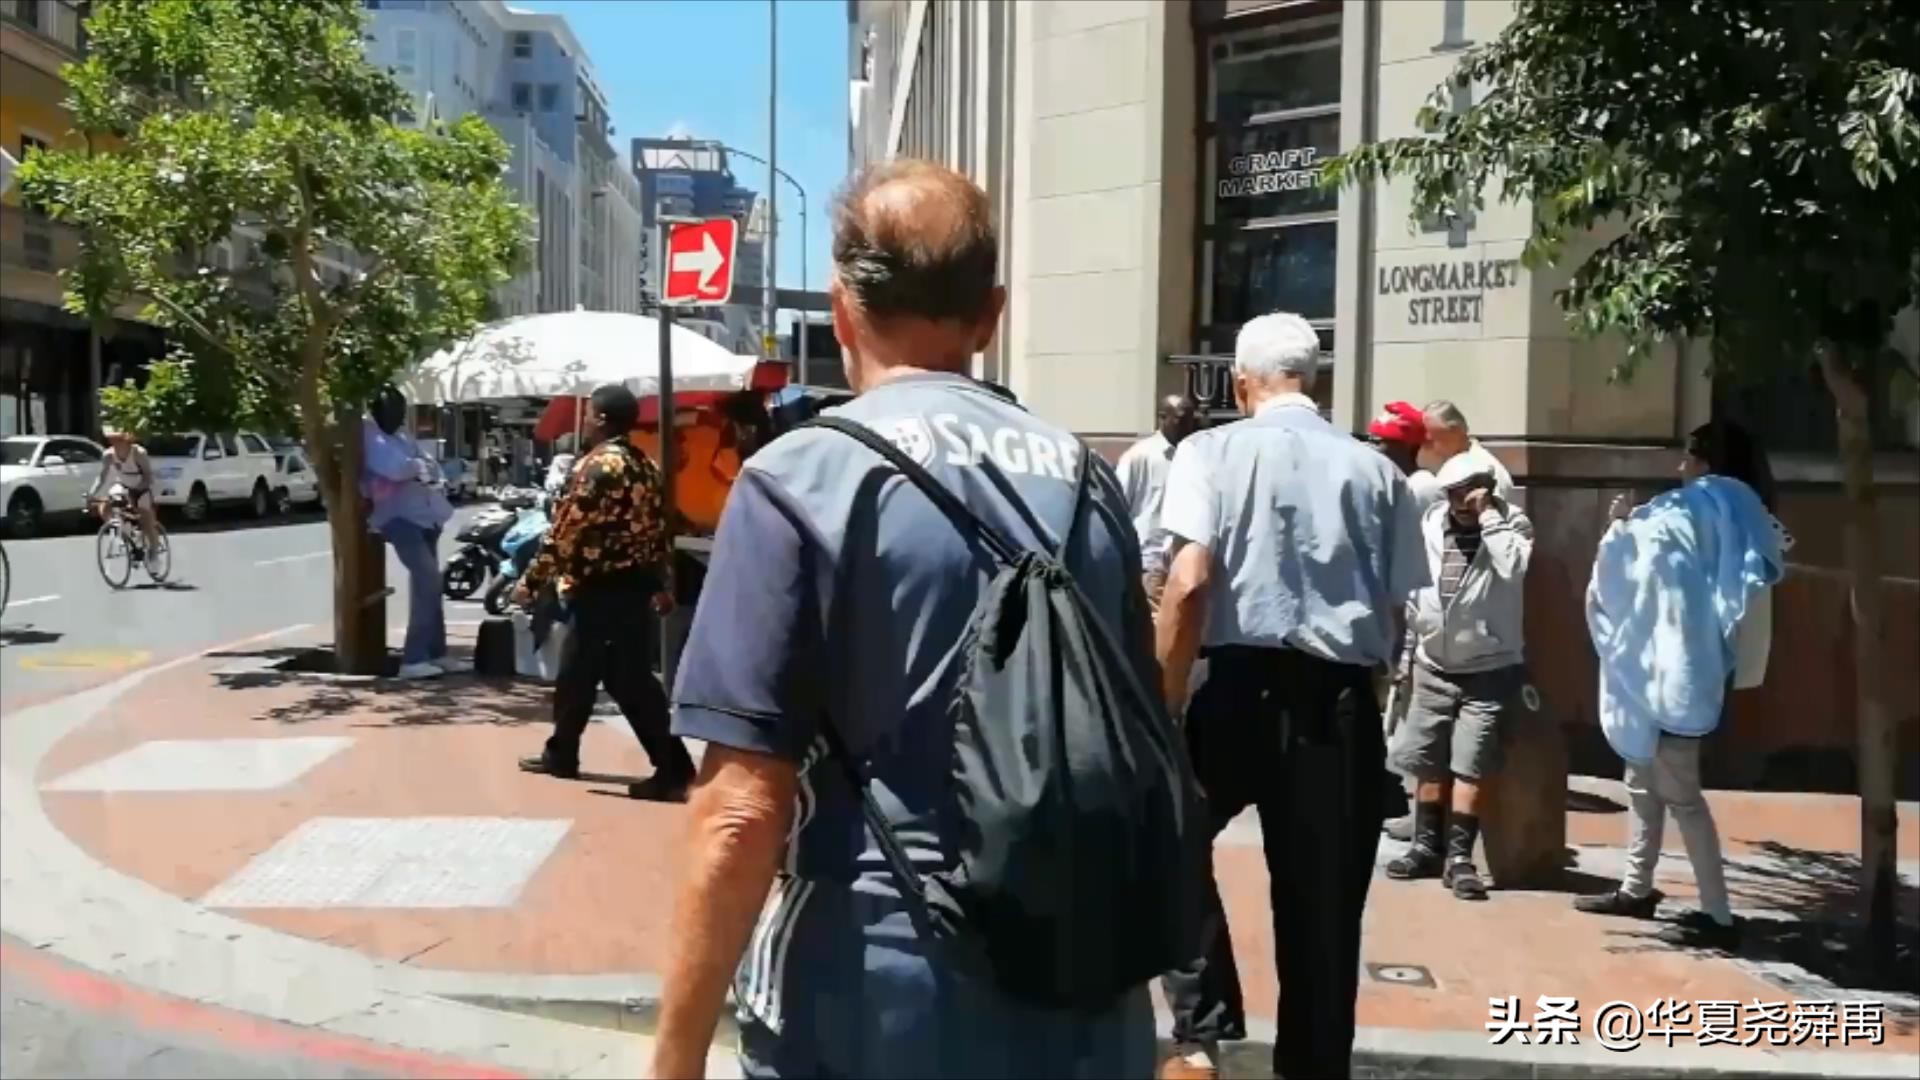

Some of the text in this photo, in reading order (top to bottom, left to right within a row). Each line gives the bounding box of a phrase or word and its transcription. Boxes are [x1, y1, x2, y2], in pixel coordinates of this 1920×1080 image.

[1229, 147, 1316, 175] CRAFT
[1219, 169, 1323, 198] MARKET
[1379, 259, 1518, 295] LONGMARKET
[1409, 296, 1483, 325] STREET
